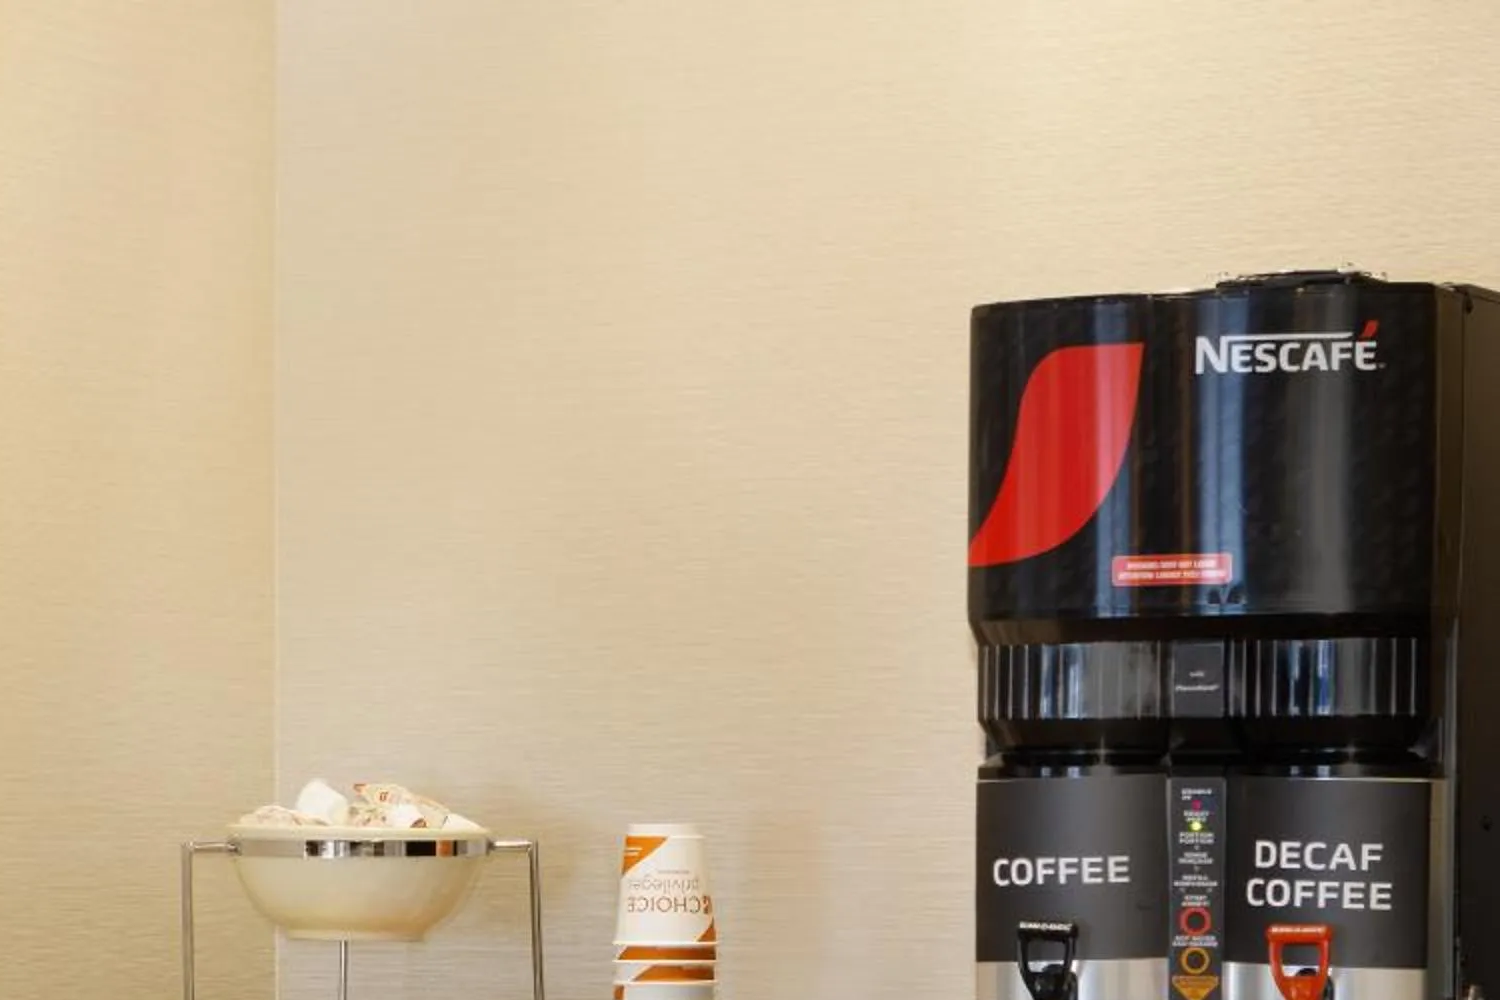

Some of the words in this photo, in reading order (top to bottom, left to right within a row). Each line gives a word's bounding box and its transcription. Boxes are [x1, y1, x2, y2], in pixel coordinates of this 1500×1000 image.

[1195, 319, 1379, 374] NESCAFÉ
[993, 855, 1131, 887] COFFEE
[1255, 840, 1383, 871] DECAF
[627, 895, 701, 914] CHOICE
[1246, 878, 1393, 910] COFFEE
